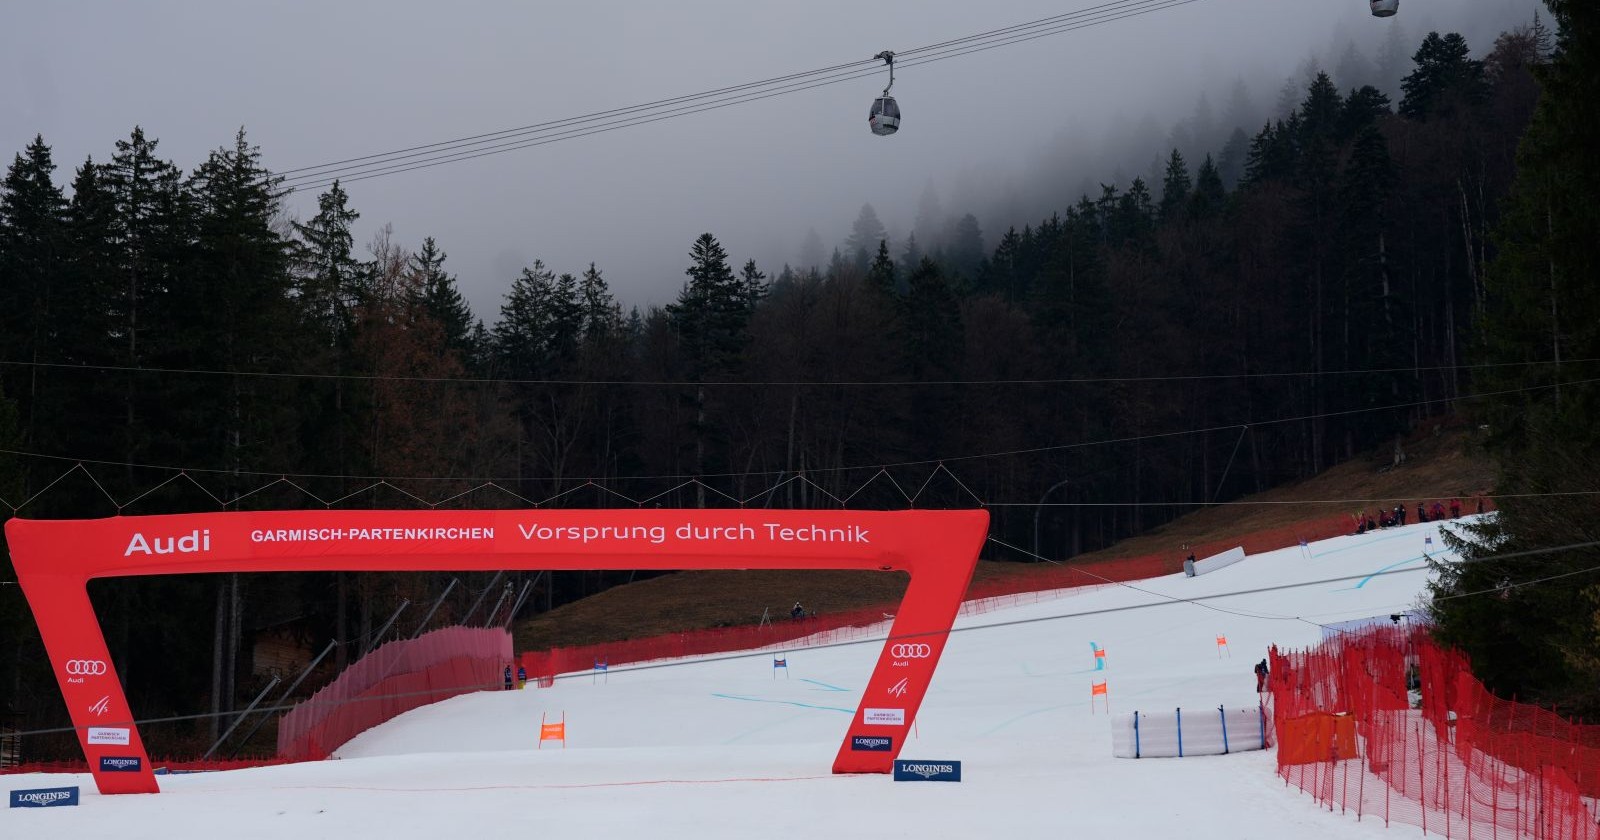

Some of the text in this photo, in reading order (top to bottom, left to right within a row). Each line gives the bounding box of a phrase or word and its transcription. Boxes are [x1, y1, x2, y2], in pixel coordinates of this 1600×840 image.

[250, 526, 495, 543] GARMISCH-PARTENKIRCHEN
[517, 522, 870, 544] Vorsprung durch Technik
[124, 528, 211, 557] Audi
[902, 764, 953, 773] LONGINES
[18, 791, 71, 802] LONGINES
